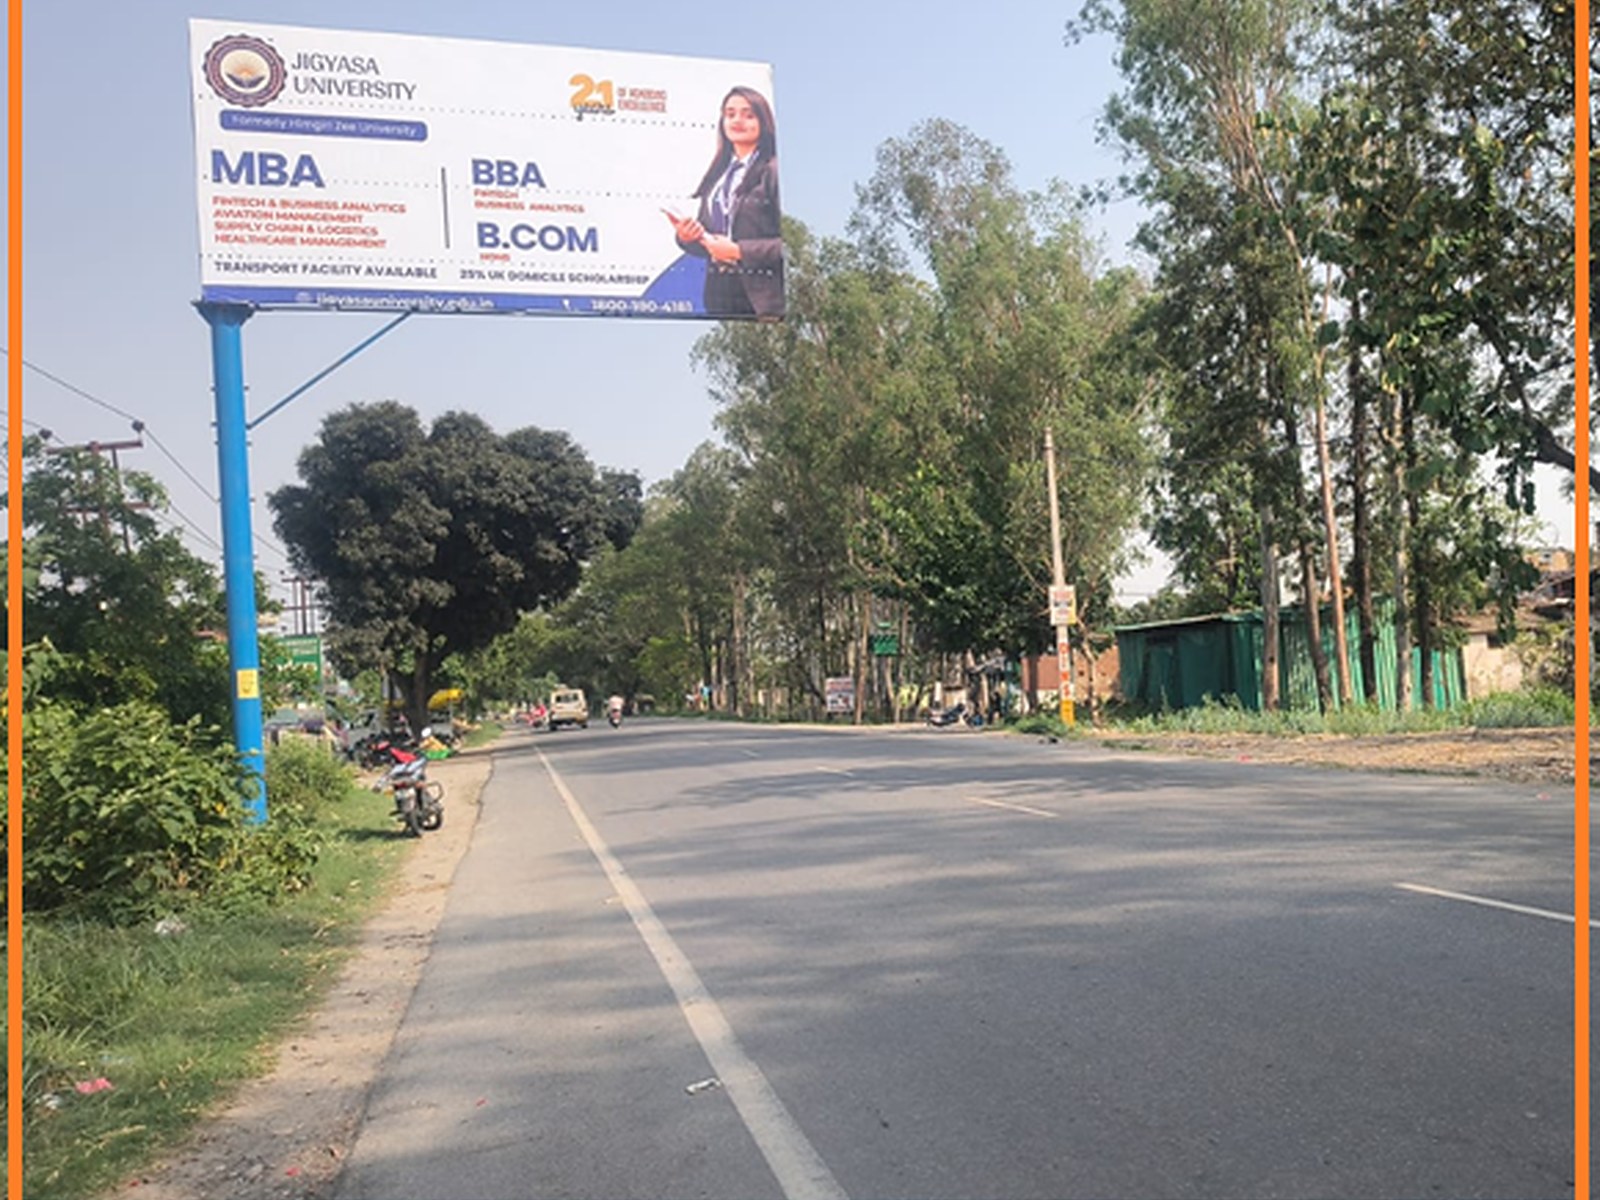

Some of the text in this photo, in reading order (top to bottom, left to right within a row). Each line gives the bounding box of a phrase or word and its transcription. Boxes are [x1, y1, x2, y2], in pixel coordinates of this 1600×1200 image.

[291, 52, 380, 76] JIGYASA
[294, 76, 417, 100] UNIVERSITY
[569, 74, 614, 109] 21
[336, 120, 356, 132] Zee
[359, 121, 417, 138] University
[211, 149, 325, 188] MBA
[471, 158, 546, 188] BBA
[212, 195, 406, 214] FINTECH & BUSINESS ANALYTICS
[474, 200, 585, 214] BUSINESS ANALYTICS
[213, 208, 363, 224] AVIATION MANAGEMENT
[214, 221, 379, 236] SUPPLY CHAIN & LOGISTICS
[476, 221, 598, 252] B.COM
[215, 234, 386, 249] HEALTHCARE MANAGEMENT
[214, 261, 438, 279] TRANSPORT FACILITY AVAILABLE
[488, 270, 505, 281] UK
[507, 270, 566, 284] DOMICILE
[568, 272, 650, 285] SCHOLARSHIP
